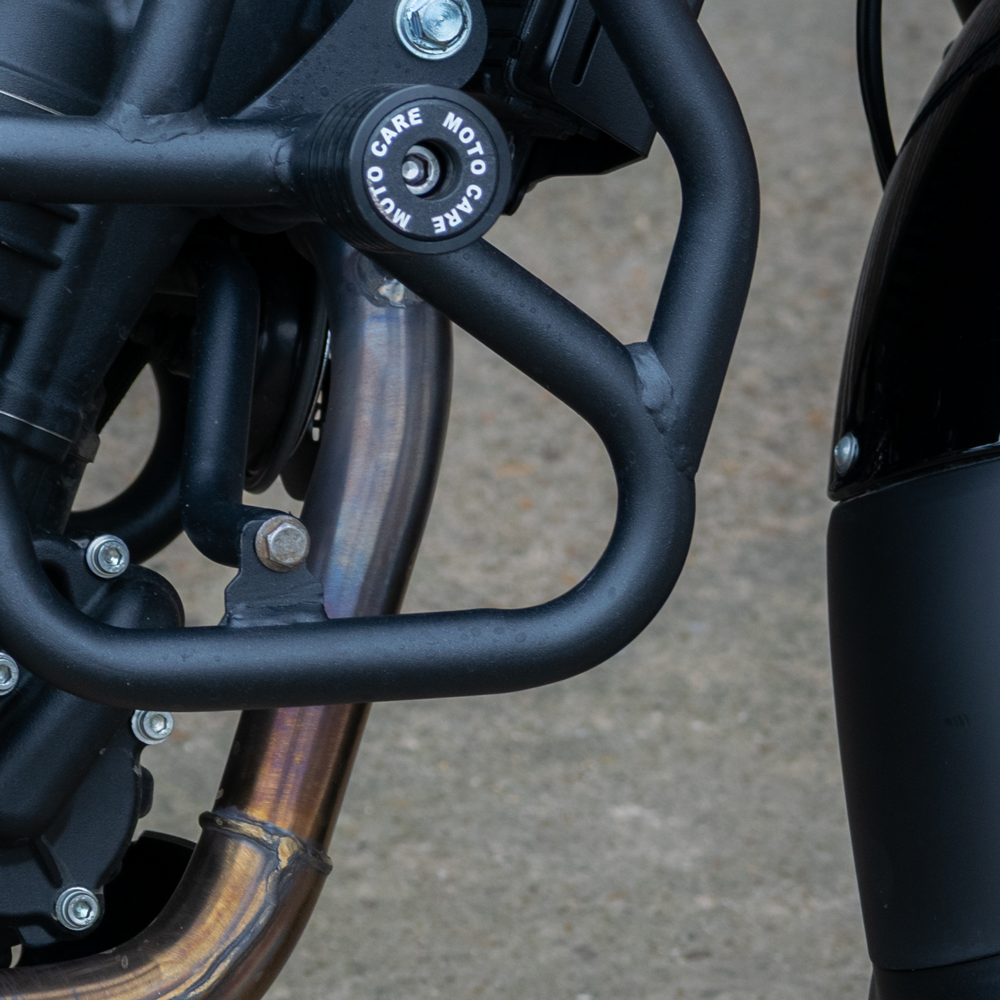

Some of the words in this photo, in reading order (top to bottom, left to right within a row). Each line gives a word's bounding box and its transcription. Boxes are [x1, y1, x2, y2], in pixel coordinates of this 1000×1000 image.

[370, 107, 423, 157] CARE
[442, 111, 486, 175] MOTO
[431, 184, 482, 234] CARE
